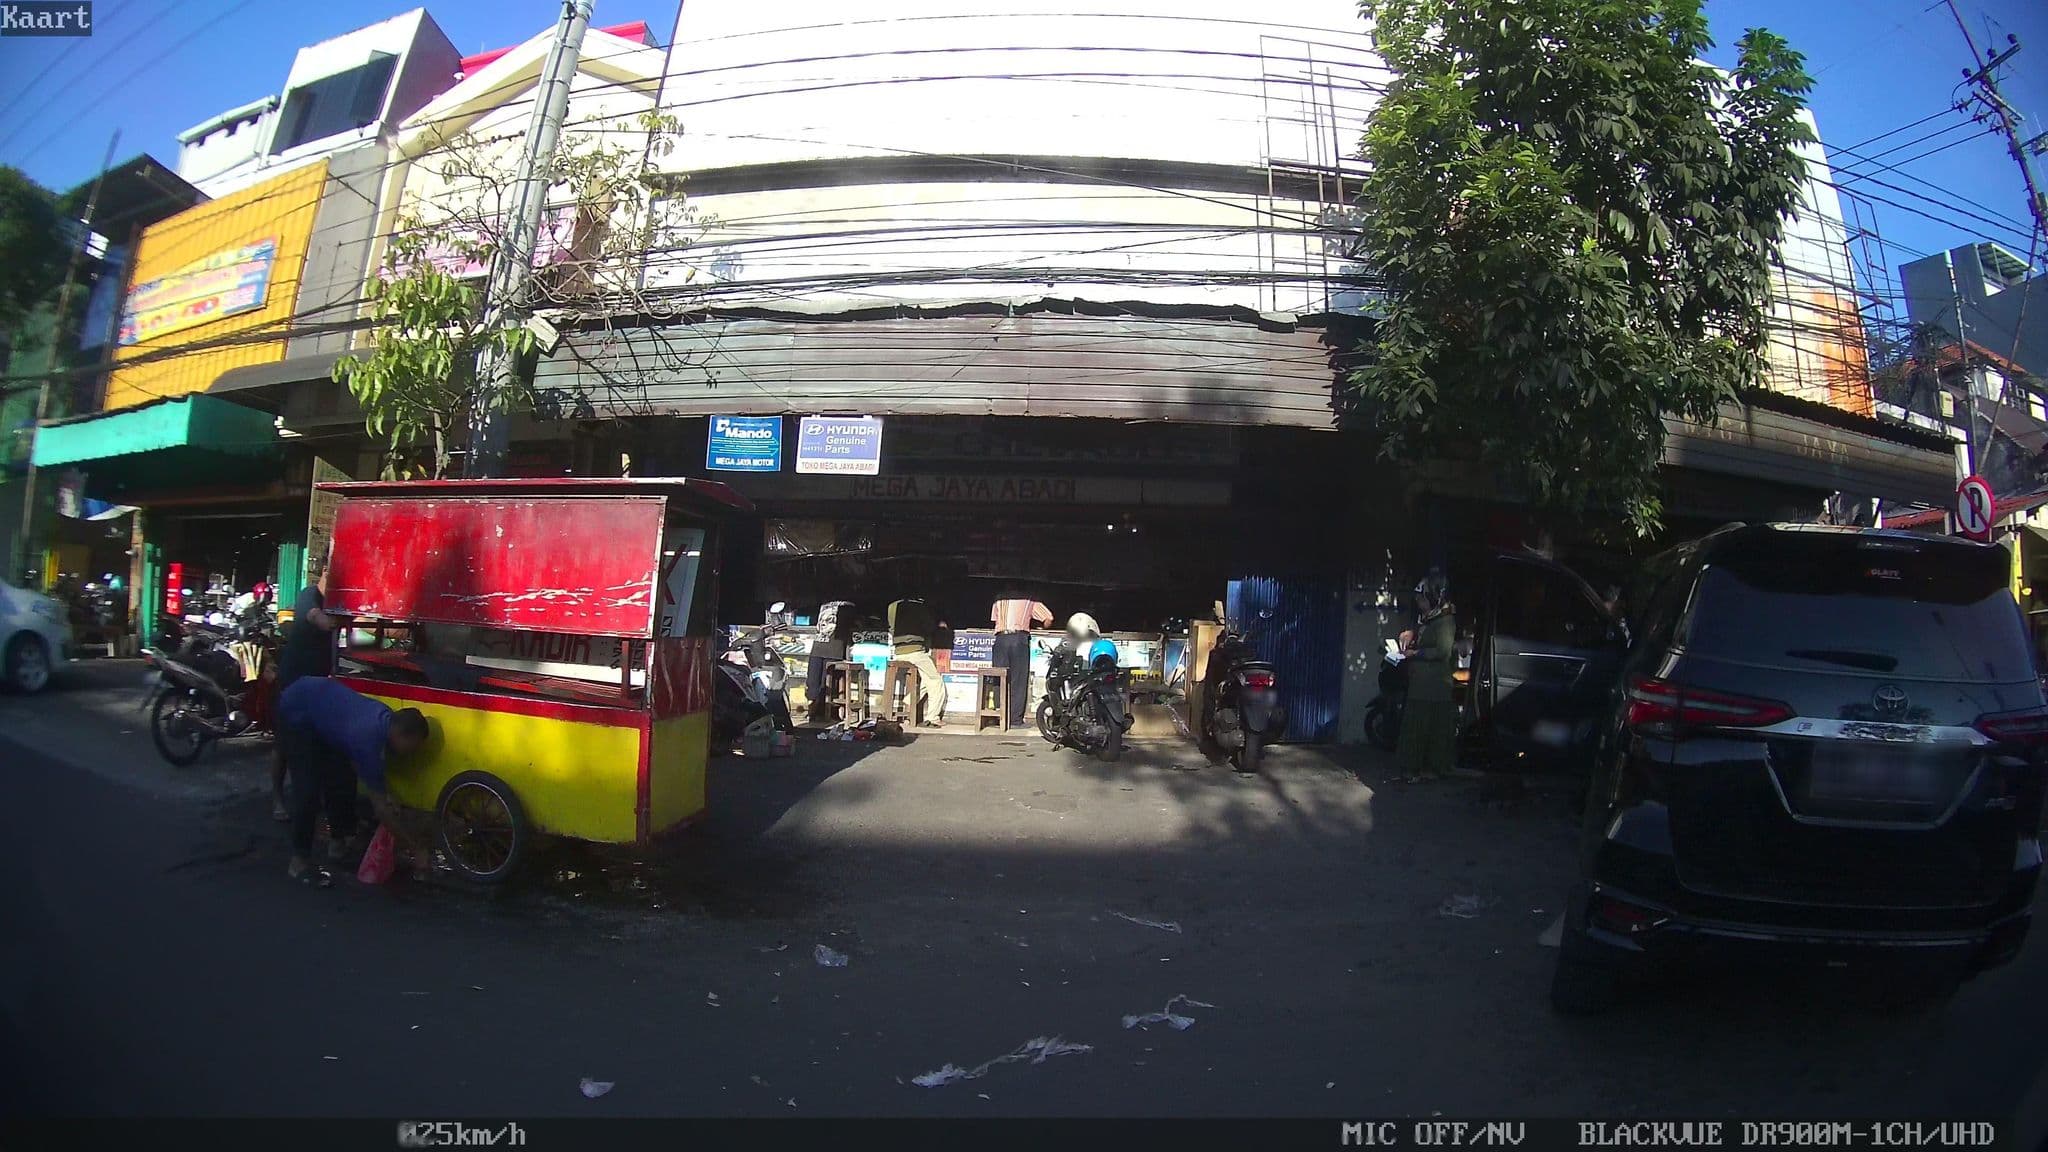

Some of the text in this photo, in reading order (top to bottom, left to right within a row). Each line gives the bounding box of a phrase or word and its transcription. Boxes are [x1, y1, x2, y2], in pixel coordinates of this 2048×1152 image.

[725, 427, 773, 439] Mando
[826, 436, 867, 445] Genuine
[825, 445, 851, 454] Parts
[801, 461, 819, 470] TOKO
[819, 462, 838, 470] MEGA
[853, 476, 1077, 499] MEGA JAYA ABADI
